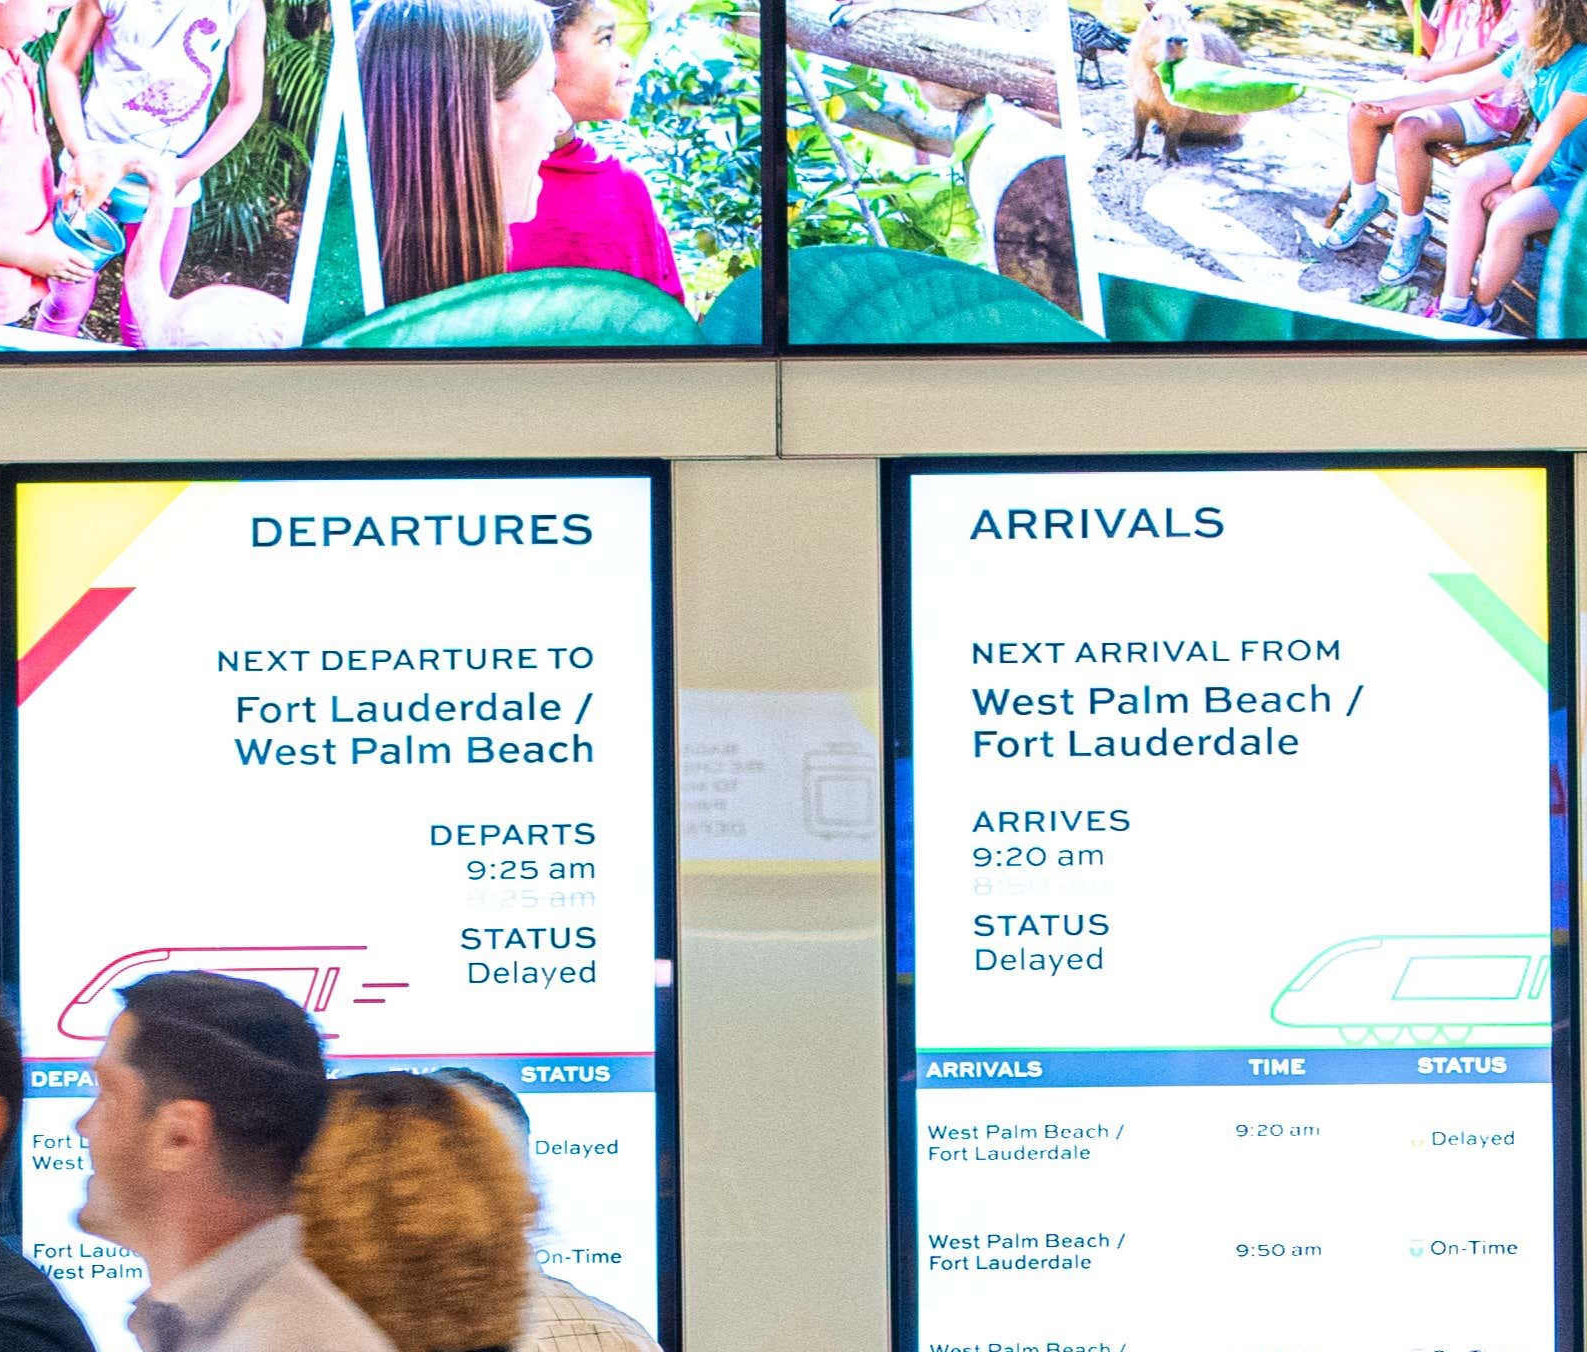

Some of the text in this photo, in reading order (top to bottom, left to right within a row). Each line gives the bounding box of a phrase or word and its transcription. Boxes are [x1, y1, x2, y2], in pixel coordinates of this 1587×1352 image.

[253, 514, 592, 547] DEPARTURES
[970, 507, 1223, 539] ARRIVALS
[219, 647, 593, 671] NEXT DEPARTURE TO
[973, 640, 1339, 664] NEXT ARRIVAL FROM
[238, 692, 593, 724] Fort Lauderdale /
[972, 684, 1363, 716] West Palm Beach /
[235, 734, 592, 765] West Palm Beach
[975, 727, 1298, 758] Fort Lauderdale
[973, 810, 1130, 832] ARRIVES
[431, 823, 595, 845] DEPARTS
[973, 847, 1103, 867] 9:20 am
[467, 861, 594, 880] 9:25 am
[974, 914, 1109, 936] STATUS
[461, 927, 596, 950] STATUS
[976, 947, 1102, 976] Delayed
[469, 960, 595, 989] Delayed
[521, 1066, 611, 1083] STATUS
[926, 1056, 1507, 1078] ARRIVALS TIME STATUS
[33, 1134, 71, 1149] Fort
[928, 1124, 1124, 1140] West Palm Beach /
[1236, 1124, 1319, 1137] 9:20 am
[1432, 1131, 1514, 1148] Delayed
[536, 1140, 618, 1158] Delayed
[929, 1145, 1090, 1161] Fort Lauderdale
[32, 1156, 84, 1170] West
[33, 1244, 73, 1259] Fort
[91, 1264, 143, 1279] Palm
